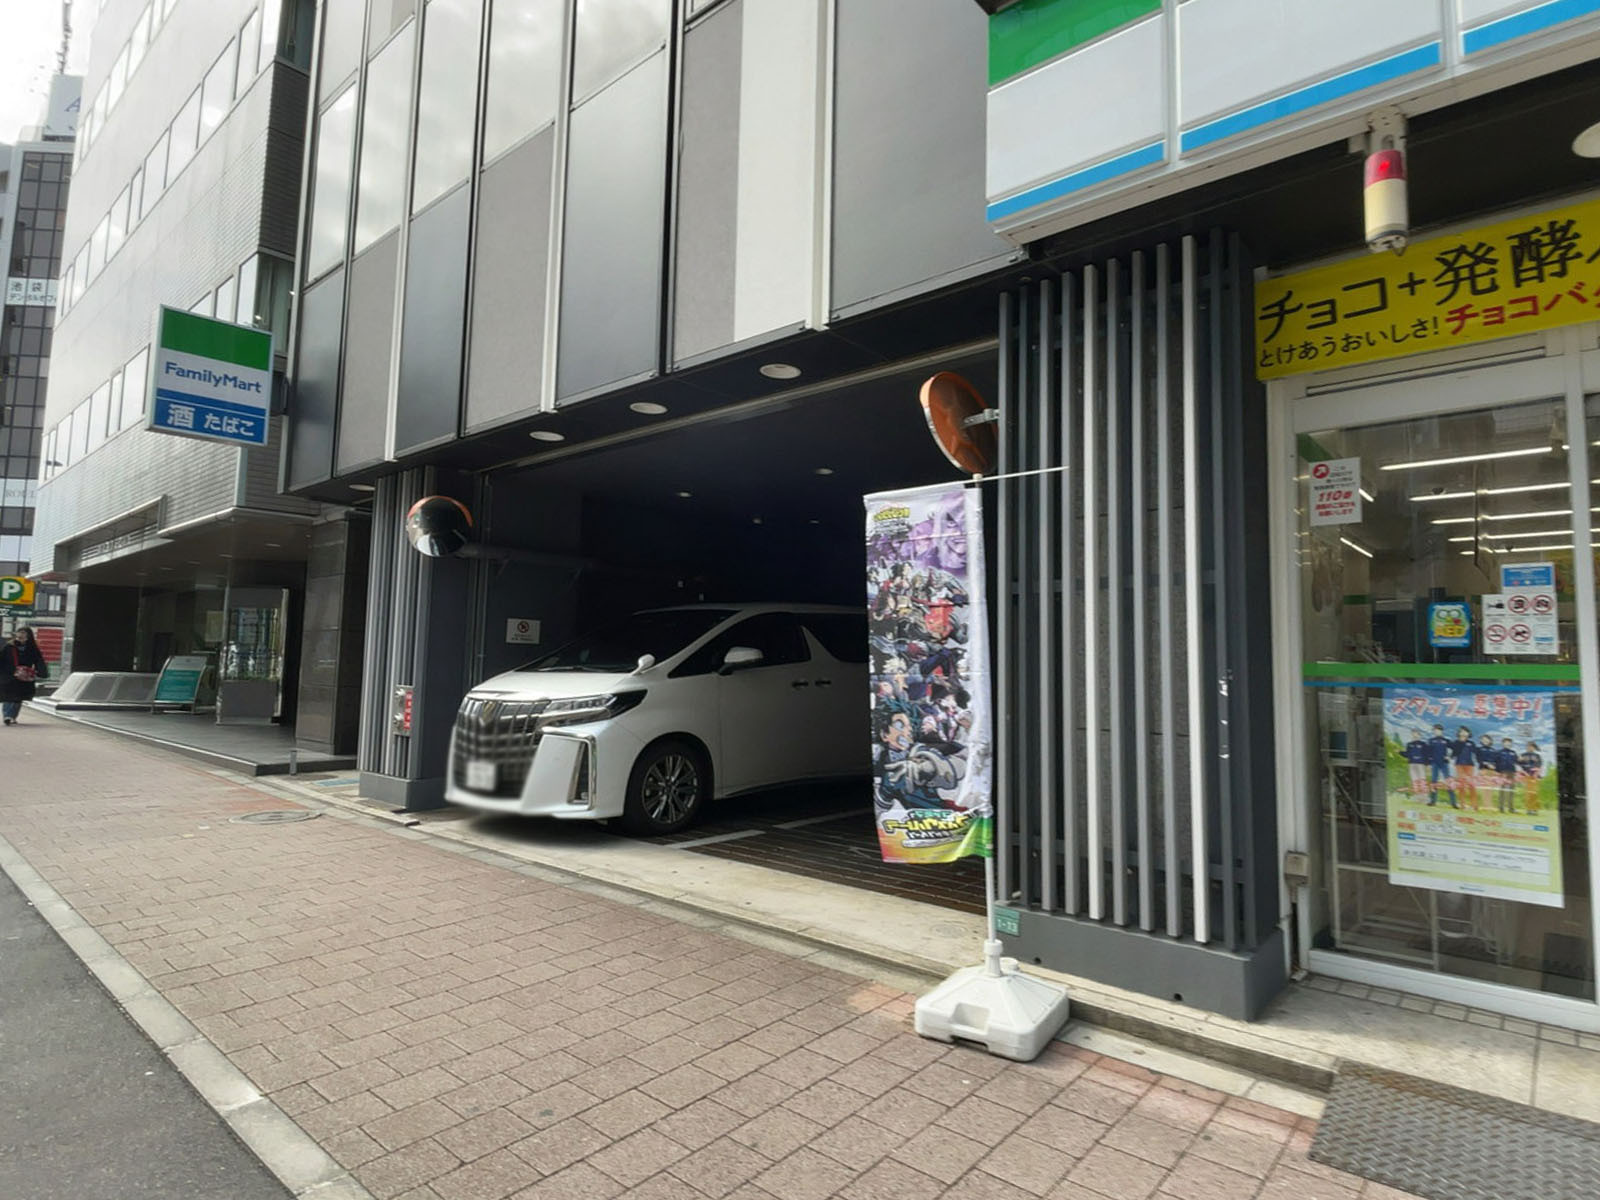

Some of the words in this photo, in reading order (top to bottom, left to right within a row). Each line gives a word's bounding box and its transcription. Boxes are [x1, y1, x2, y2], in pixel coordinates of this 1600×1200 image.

[1259, 219, 1600, 343] チョコ+発酵
[1259, 316, 1439, 368] とけあうおいしさ!
[164, 361, 262, 393] FamilyMart
[167, 403, 195, 429] 酒
[204, 413, 255, 436] たばこ
[1, 581, 21, 599] P
